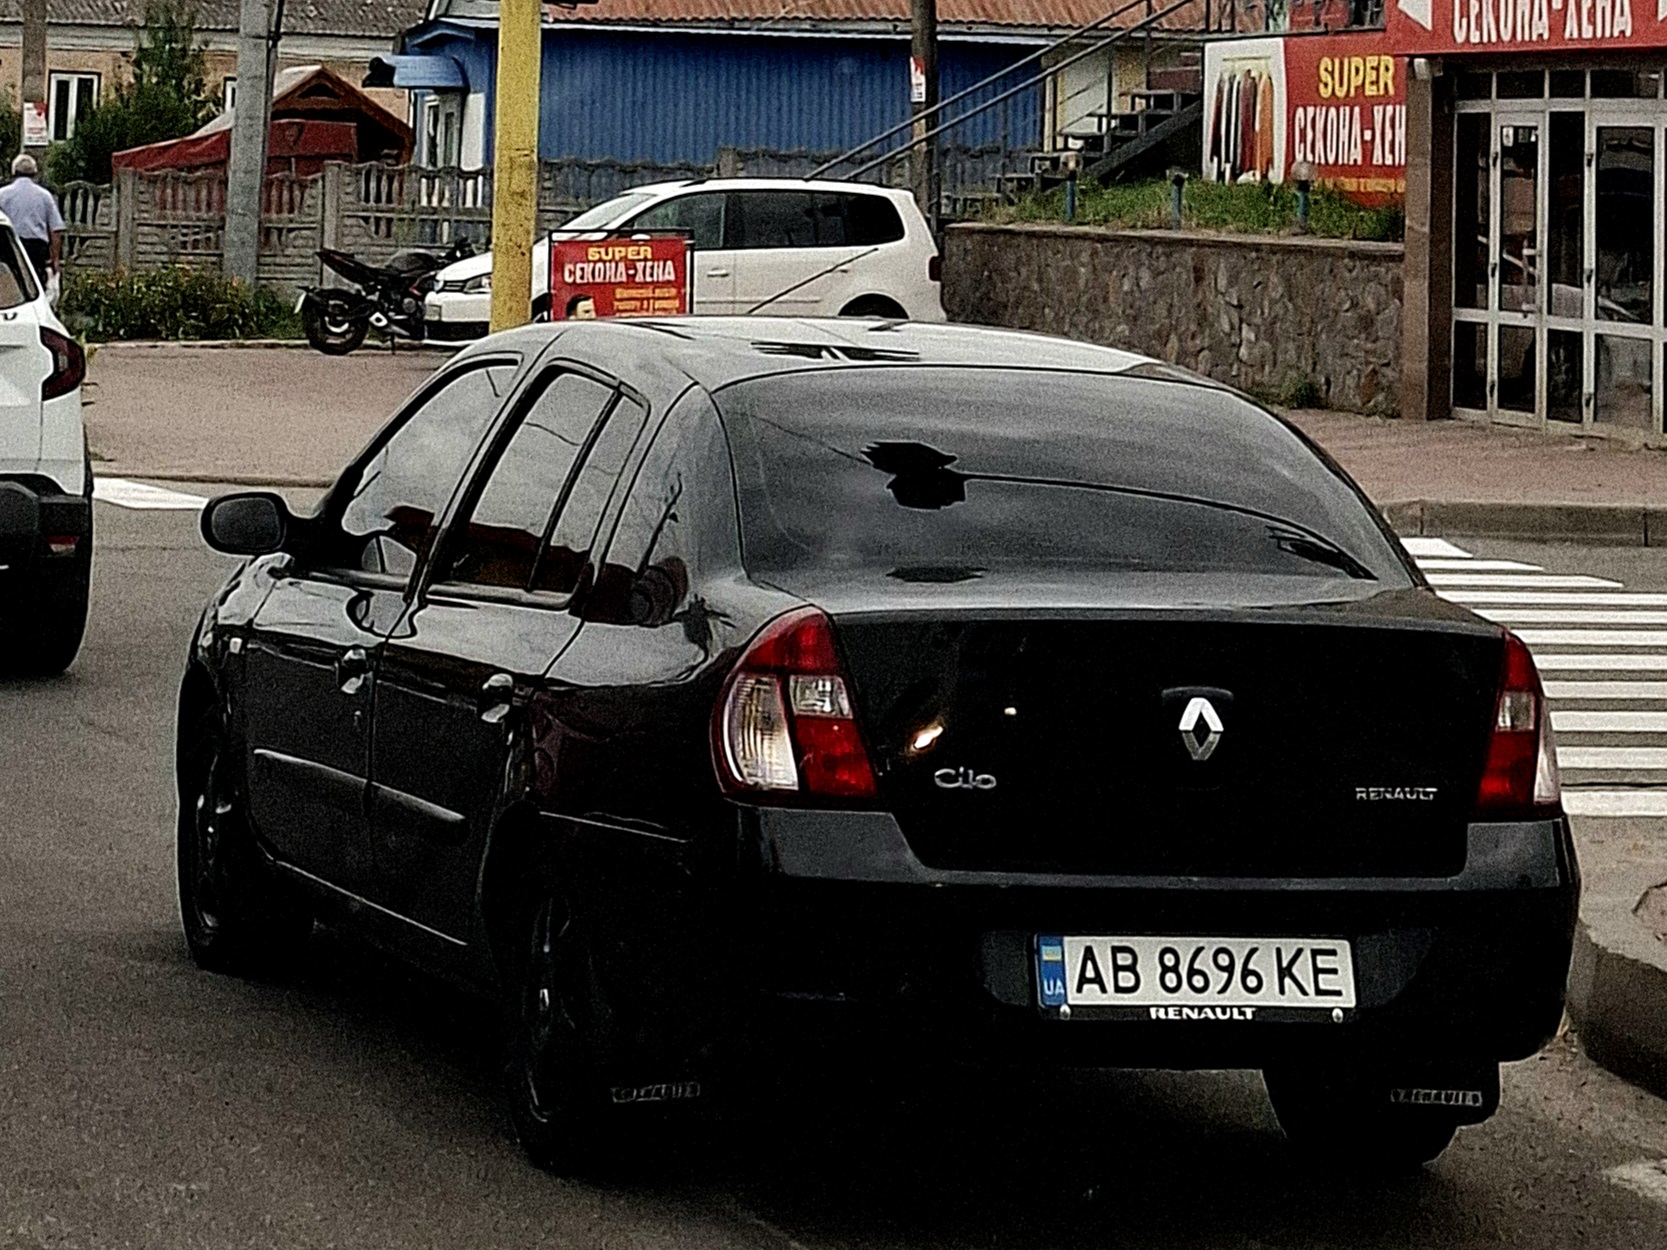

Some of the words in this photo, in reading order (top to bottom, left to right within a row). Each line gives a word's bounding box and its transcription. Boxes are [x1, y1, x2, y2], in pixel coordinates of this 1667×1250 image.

[1318, 56, 1395, 98] SUPER
[587, 246, 652, 261] SUPER
[1355, 787, 1438, 801] RENAULT
[1075, 945, 1141, 995] AB
[1157, 946, 1264, 995] 8696
[1274, 946, 1343, 997] KE
[1043, 978, 1065, 996] UA
[1149, 1006, 1256, 1020] RENAULT
